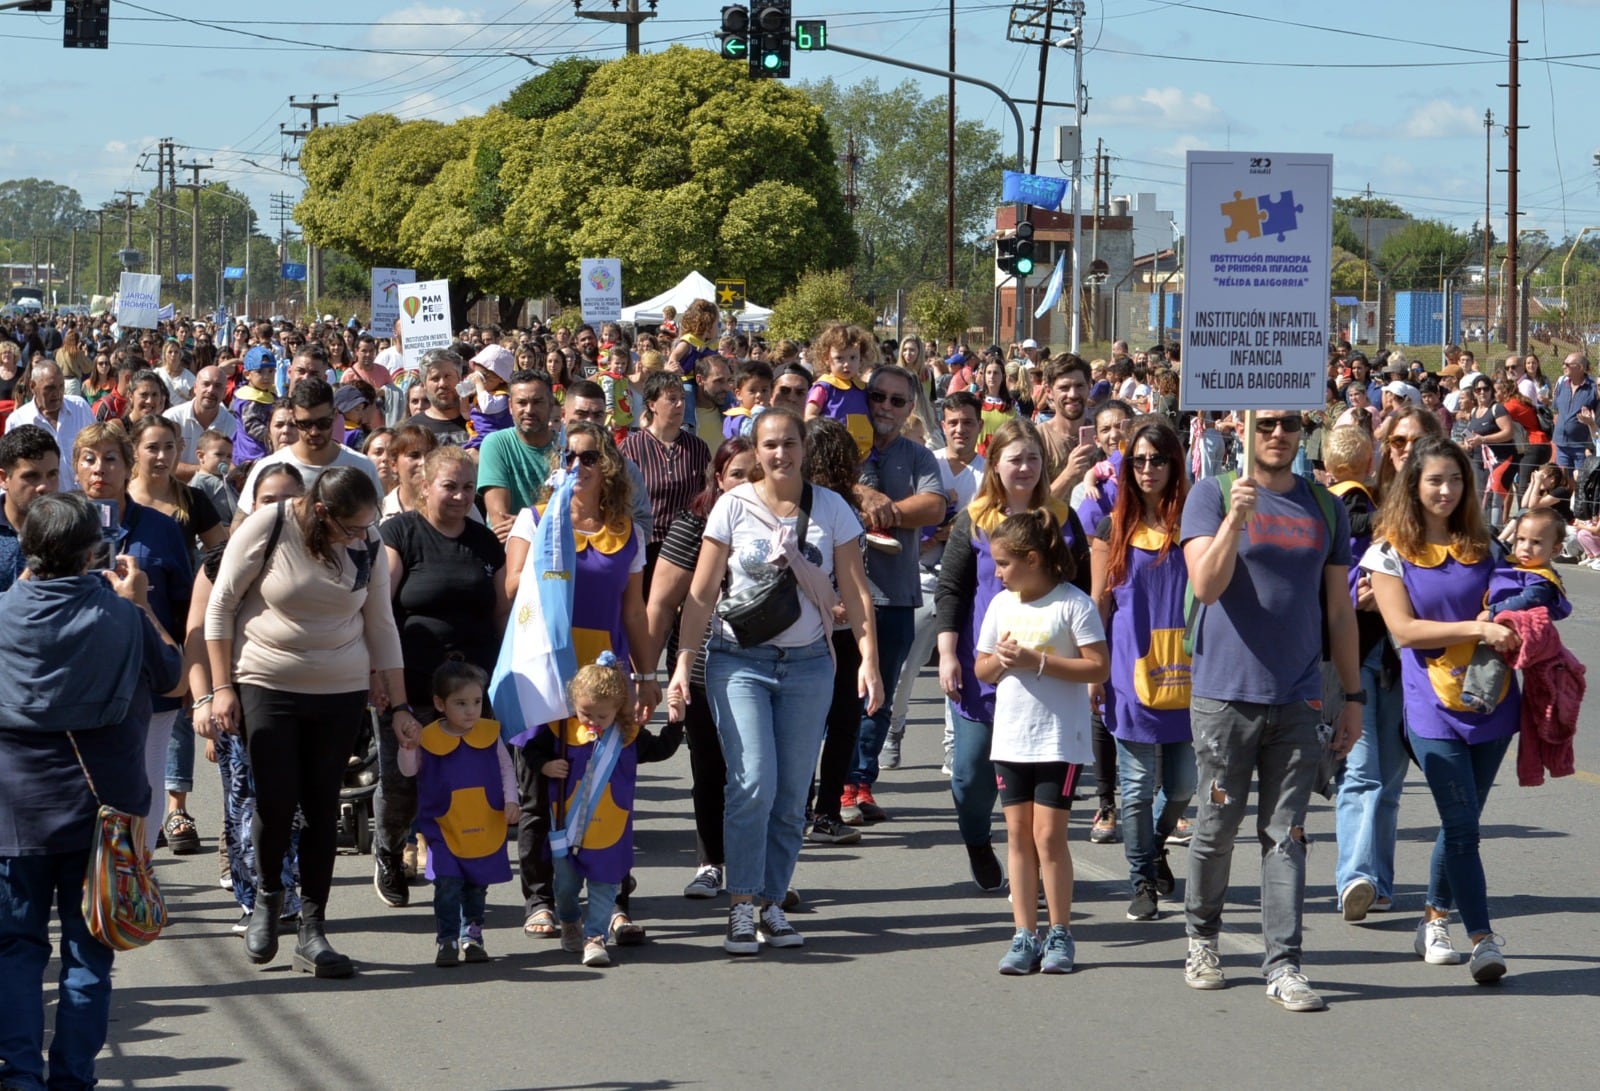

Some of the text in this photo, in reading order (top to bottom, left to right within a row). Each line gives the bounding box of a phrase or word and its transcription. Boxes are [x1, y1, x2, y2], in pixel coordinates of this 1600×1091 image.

[422, 295, 442, 304] PAM
[422, 304, 434, 313] PE
[423, 313, 445, 322] RITO
[1195, 308, 1319, 328] INSTITUCIÓN INFANTIL
[1190, 330, 1323, 347] MUNICIPAL DE PRIMERA
[1230, 350, 1282, 366] INFANCIA
